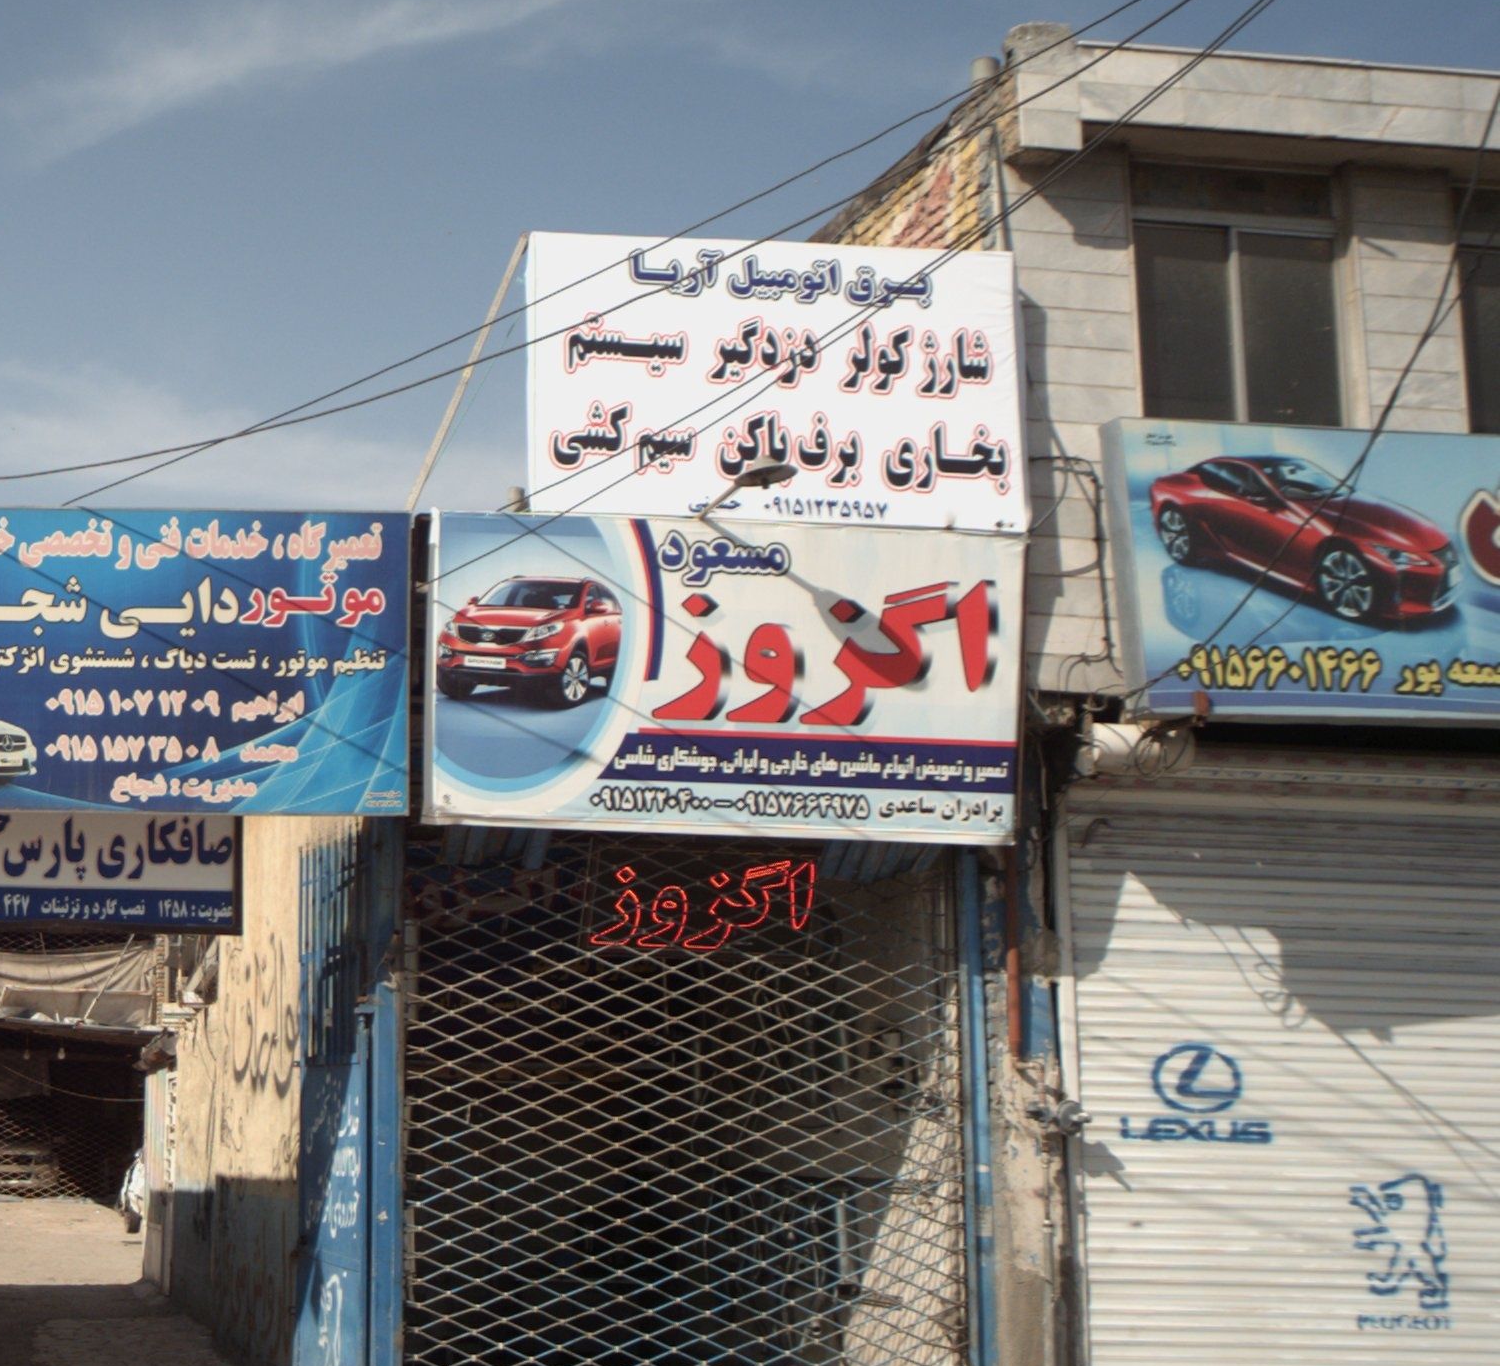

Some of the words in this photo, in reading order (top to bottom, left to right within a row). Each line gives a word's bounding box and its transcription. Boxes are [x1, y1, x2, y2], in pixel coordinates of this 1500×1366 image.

[629, 248, 724, 297] آریا
[728, 254, 842, 304] اتومبیل
[845, 266, 934, 309] برق
[565, 312, 688, 378] سیستم
[707, 316, 822, 388] دزدگیر
[840, 321, 914, 394] کولر
[916, 327, 994, 398] شارژ
[550, 400, 633, 471] کشی
[633, 427, 697, 475] سیم
[795, 411, 864, 488] برف
[882, 421, 1011, 495] بخاری
[18, 517, 113, 569] تخصصی
[114, 534, 132, 570] و
[135, 516, 182, 570] فنی
[185, 519, 269, 560] خدمات
[658, 529, 791, 587] مسعود
[100, 576, 238, 639] دایی
[238, 571, 386, 627] موتور
[50, 646, 136, 675] شستشوی
[212, 649, 257, 670] تست
[333, 649, 387, 677] تنظیم
[652, 580, 992, 726] اگزوز
[1177, 643, 1382, 693] ۰۹۱۵۶۶۰۱۴۶۶
[1395, 659, 1444, 696] پور
[45, 688, 105, 717] ۰۹۱۵
[109, 688, 154, 717] ۱۰۷
[191, 689, 221, 717] ۰۹
[232, 689, 305, 724] ابراهیم
[44, 734, 98, 763] ۰۹۱۵
[101, 734, 146, 763] ۱۵۷
[239, 743, 299, 763] محمد
[614, 743, 656, 770] شاسی
[657, 746, 718, 773] جوشکاری
[770, 750, 808, 776] خارجی
[809, 751, 839, 777] های
[840, 751, 881, 778] ماشین
[759, 756, 769, 775] و
[882, 754, 915, 780] انواع
[916, 759, 963, 781] تعویض
[963, 764, 973, 782] و
[975, 761, 1009, 783] تعمیر
[110, 772, 167, 803] شجاع
[879, 795, 936, 819] ساعدی
[941, 797, 1004, 823] برادران
[4, 815, 86, 881] پارس
[97, 816, 234, 879] صافکاری
[83, 905, 91, 920] و
[120, 898, 147, 917] نصب
[590, 859, 816, 950] اگزوز
[1119, 1115, 1274, 1145] LEXUS
